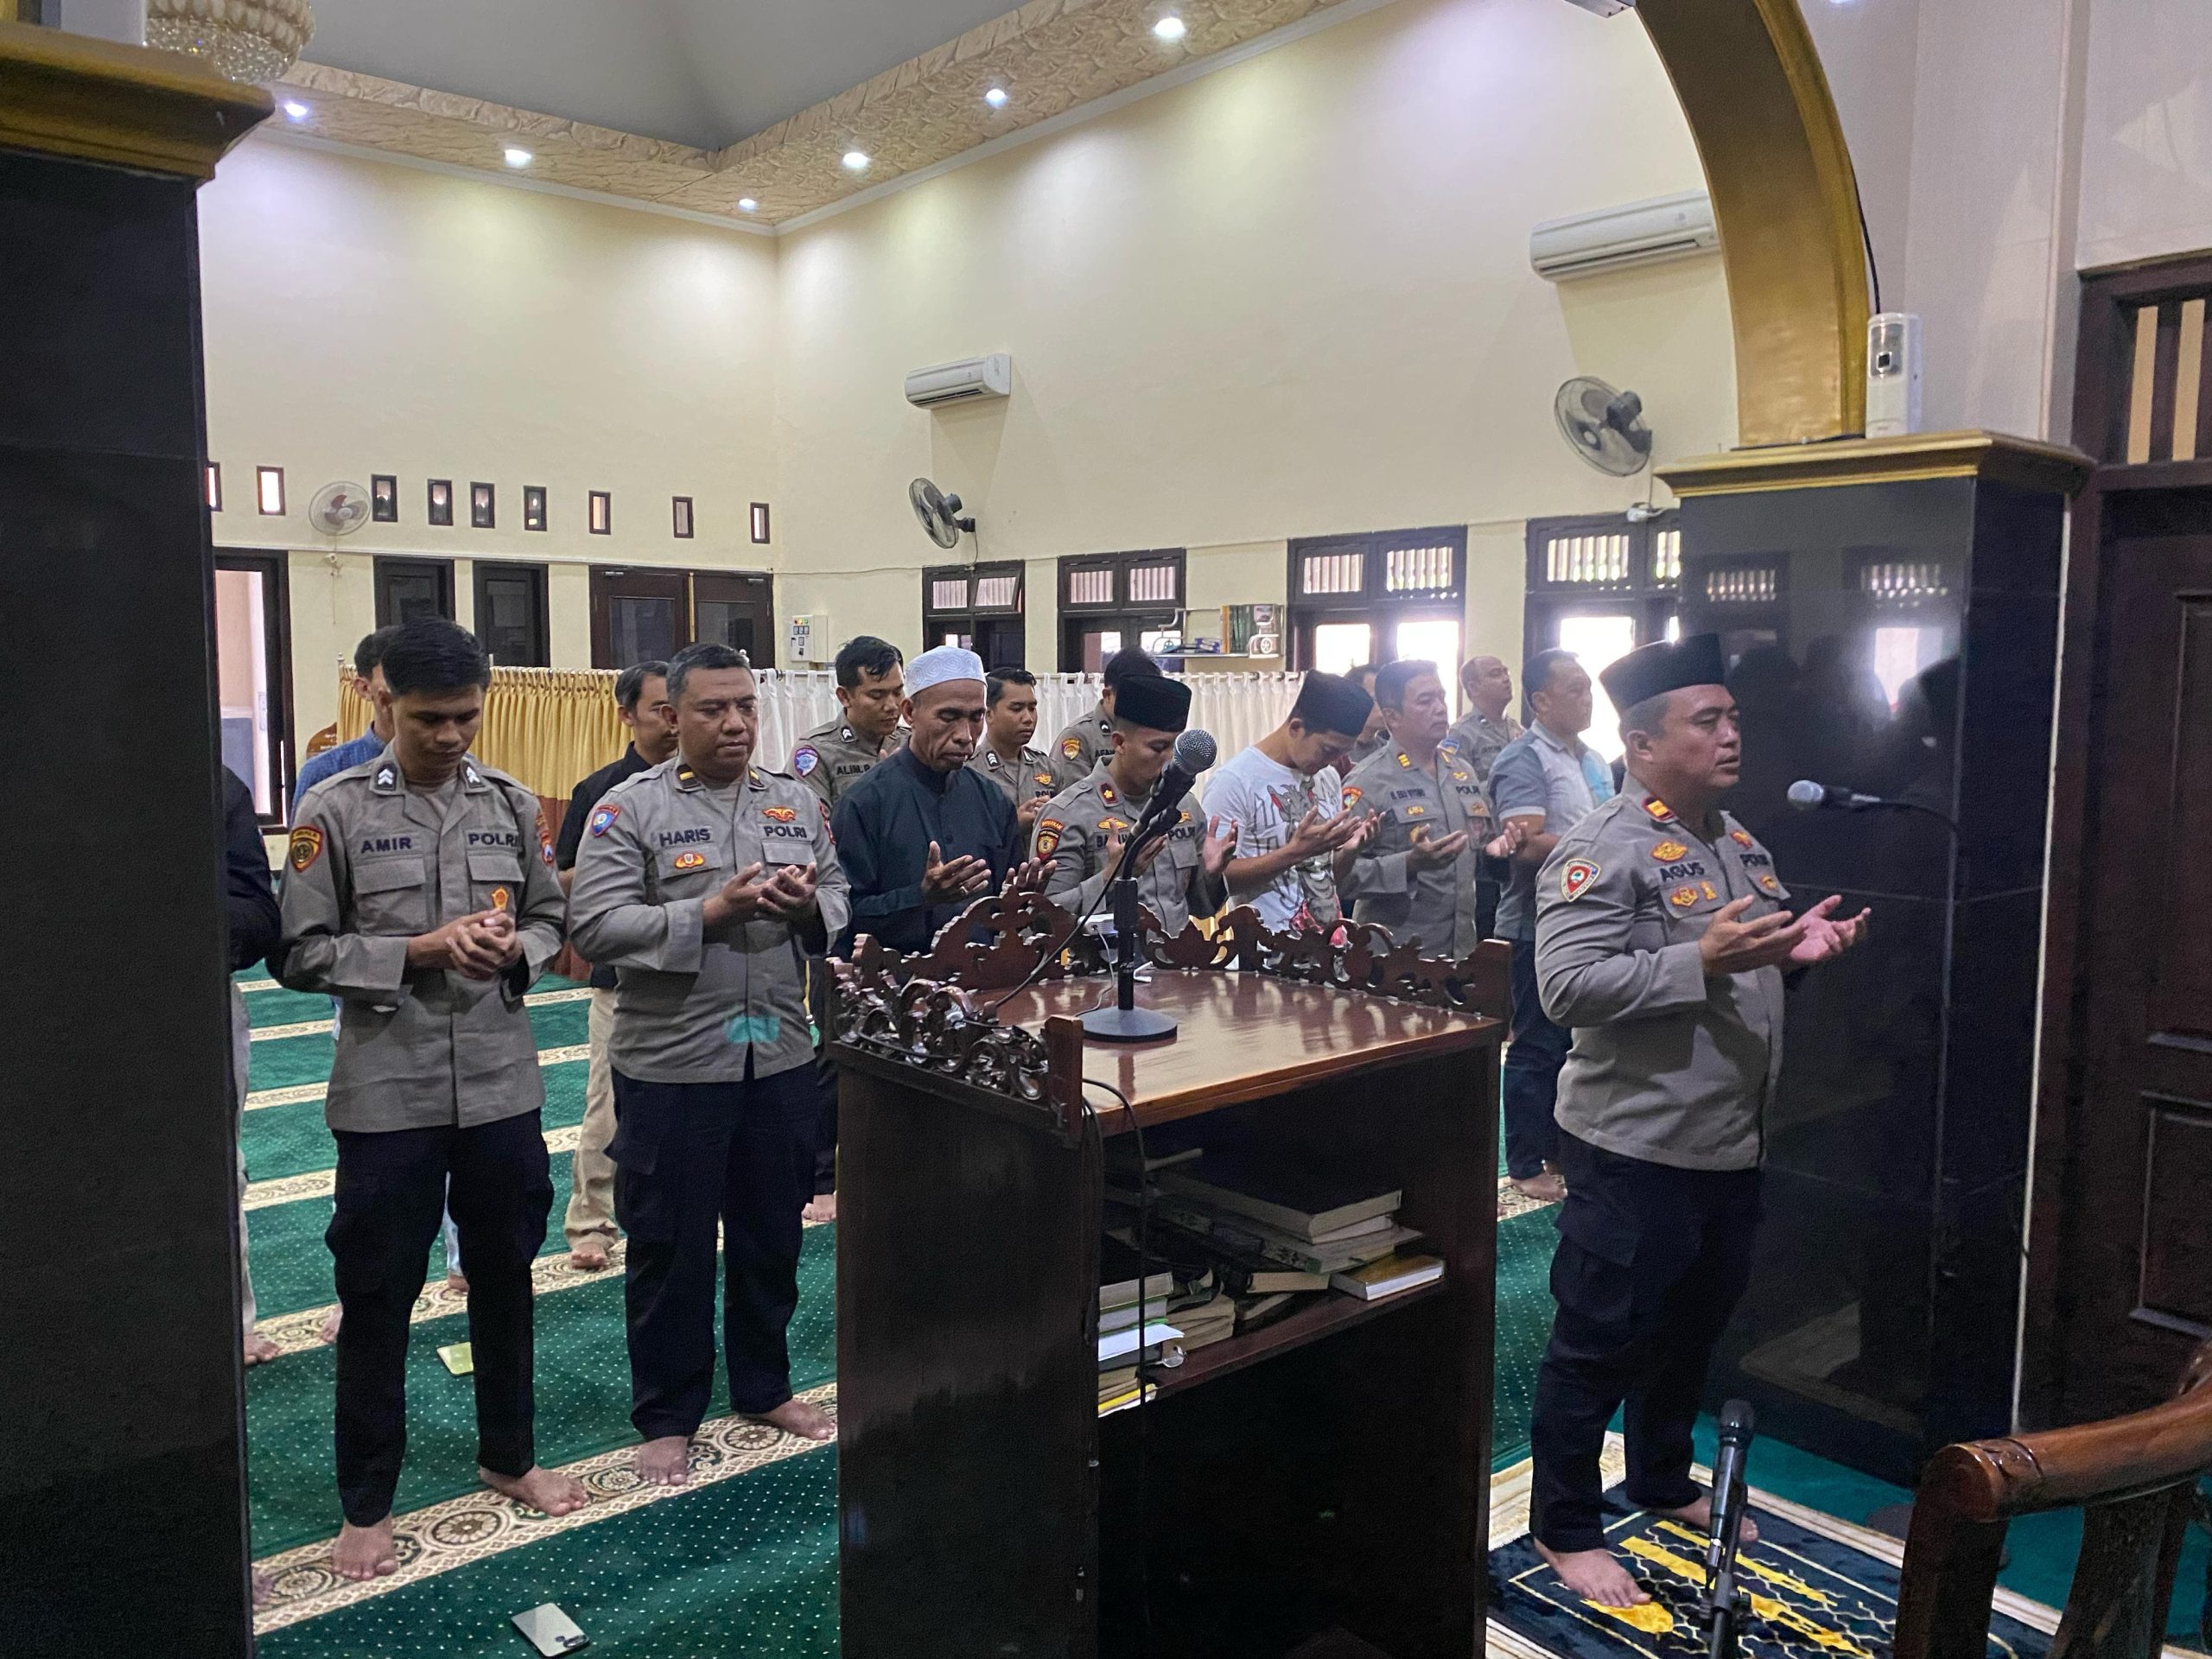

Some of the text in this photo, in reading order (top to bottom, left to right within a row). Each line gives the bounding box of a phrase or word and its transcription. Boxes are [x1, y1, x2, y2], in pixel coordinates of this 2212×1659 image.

[1035, 790, 1056, 798] POL
[659, 828, 711, 847] HARIS
[764, 824, 807, 838] POLRI
[361, 836, 412, 853] AMIR
[467, 833, 518, 848] POLRI
[1660, 862, 1705, 881] AGUS
